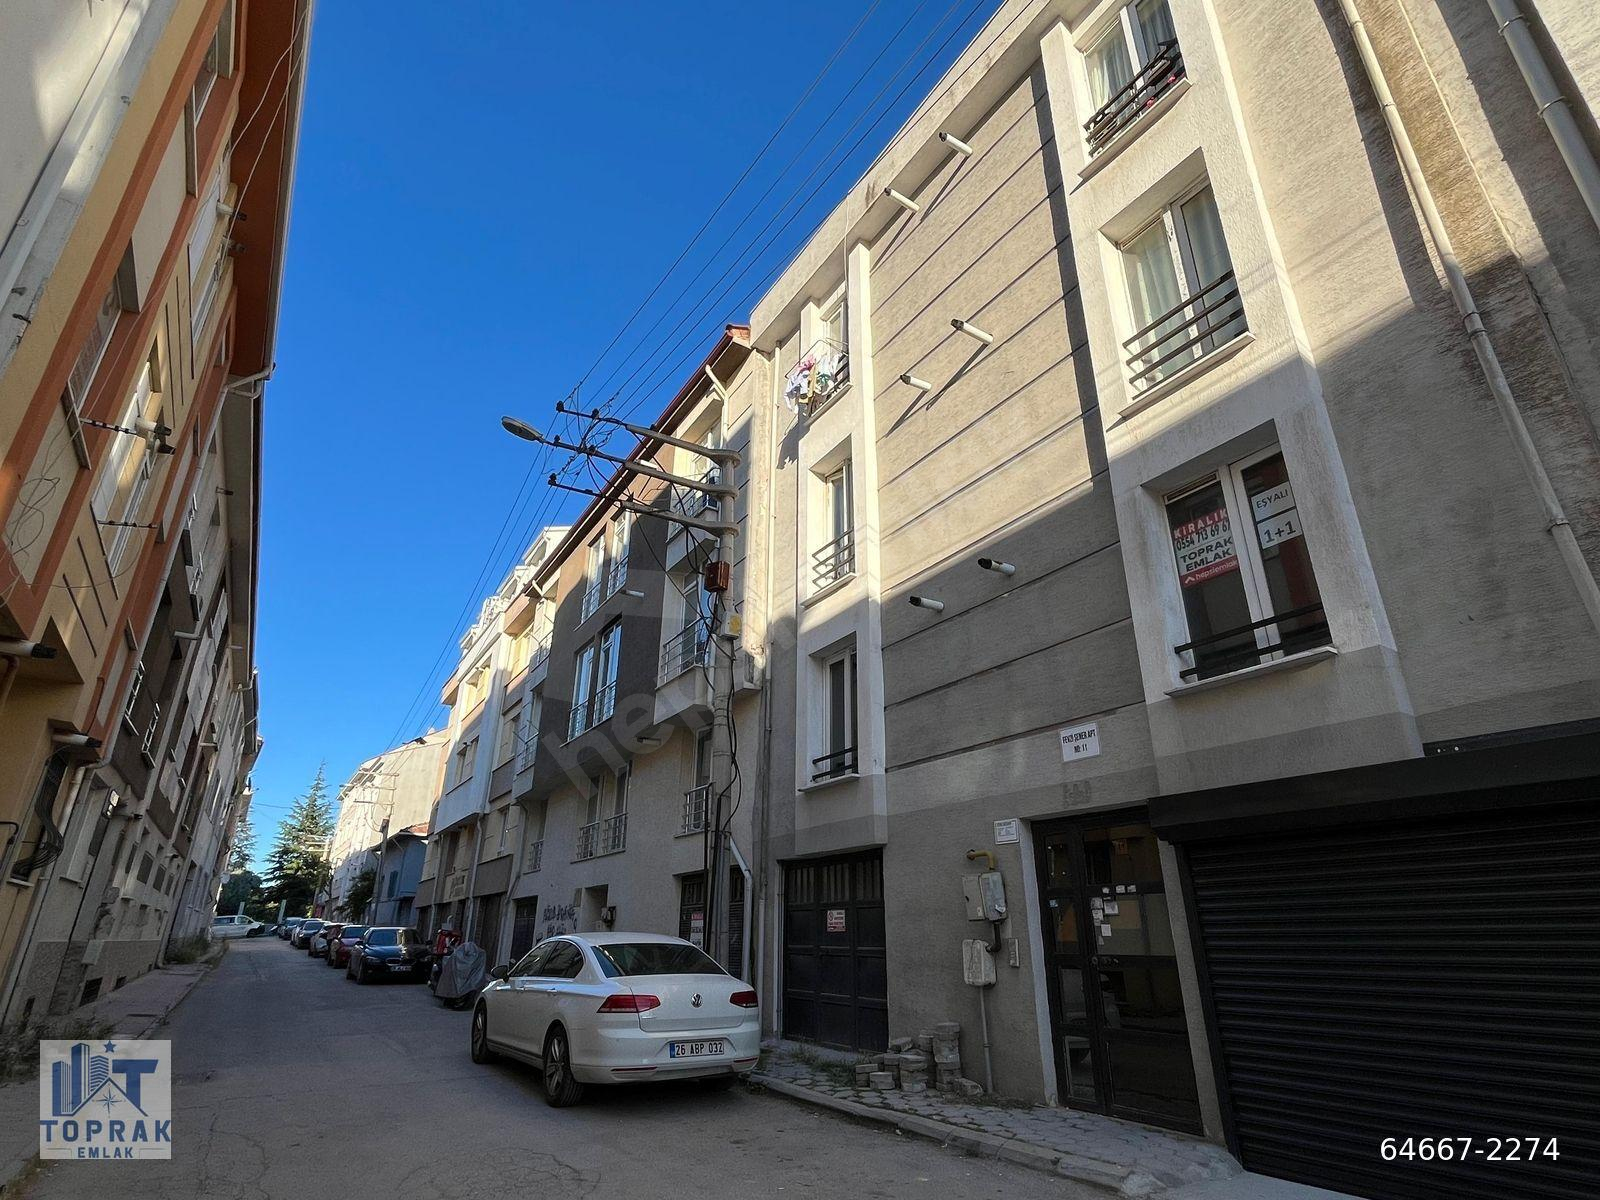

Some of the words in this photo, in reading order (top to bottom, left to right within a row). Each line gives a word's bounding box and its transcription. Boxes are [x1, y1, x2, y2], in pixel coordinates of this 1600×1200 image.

[1174, 508, 1228, 539] KIRALIK
[1264, 520, 1296, 544] 1+1
[1180, 536, 1233, 563] TOPRAK
[1186, 547, 1233, 572] EMLAK
[676, 1044, 686, 1056] 26
[690, 1043, 704, 1055] ABP
[708, 1042, 723, 1053] 032
